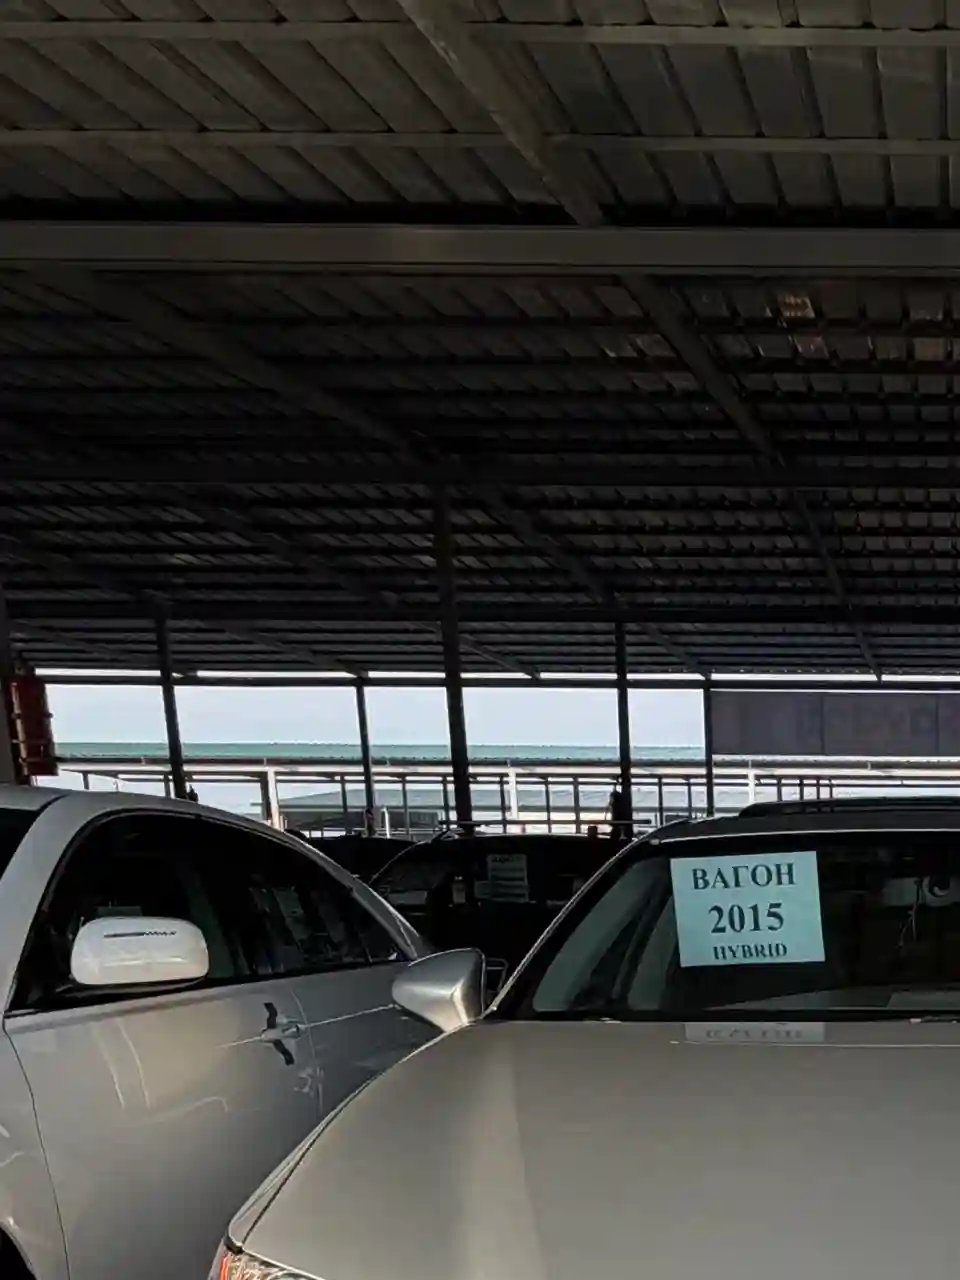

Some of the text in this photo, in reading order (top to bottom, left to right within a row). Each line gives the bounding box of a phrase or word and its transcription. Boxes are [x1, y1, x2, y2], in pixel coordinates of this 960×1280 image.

[692, 863, 797, 890] ВАГОН
[708, 902, 784, 933] 2015
[713, 942, 788, 960] HYBRID
